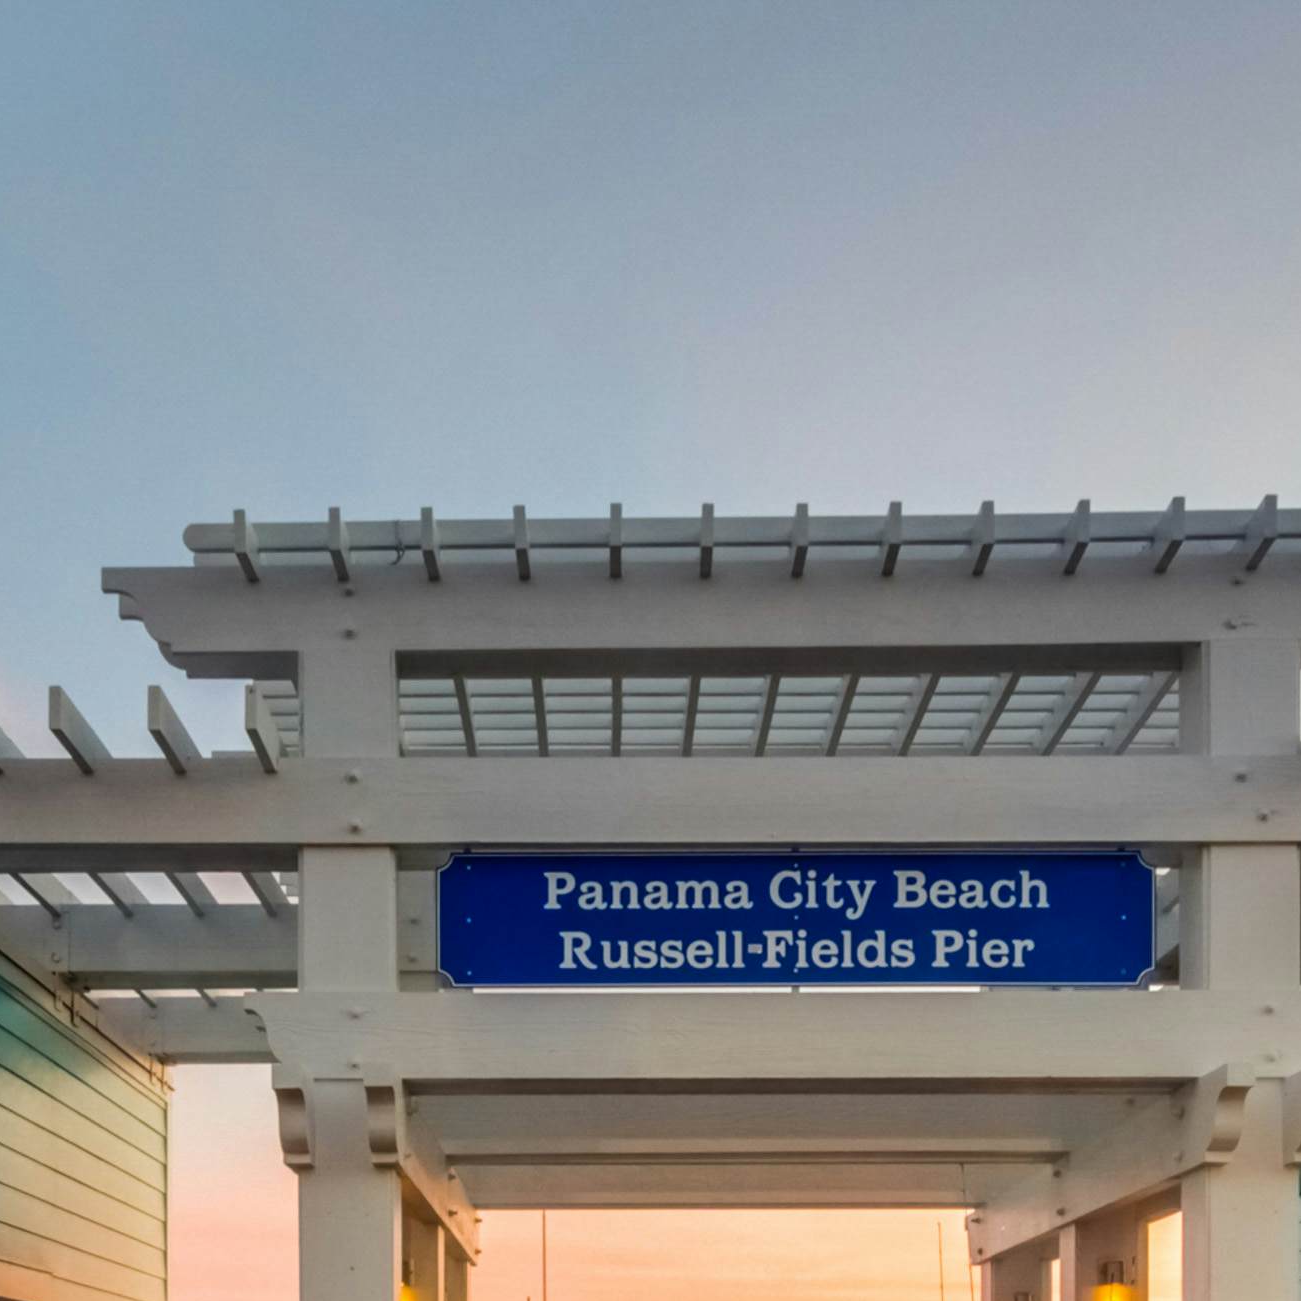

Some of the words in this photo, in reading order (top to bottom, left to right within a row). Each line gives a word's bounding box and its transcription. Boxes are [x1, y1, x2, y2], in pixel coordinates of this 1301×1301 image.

[544, 872, 753, 910] Panama
[769, 870, 876, 919] City
[893, 869, 1051, 910] Beach
[559, 929, 916, 969] Russell-Fields
[930, 930, 1036, 969] Pier
